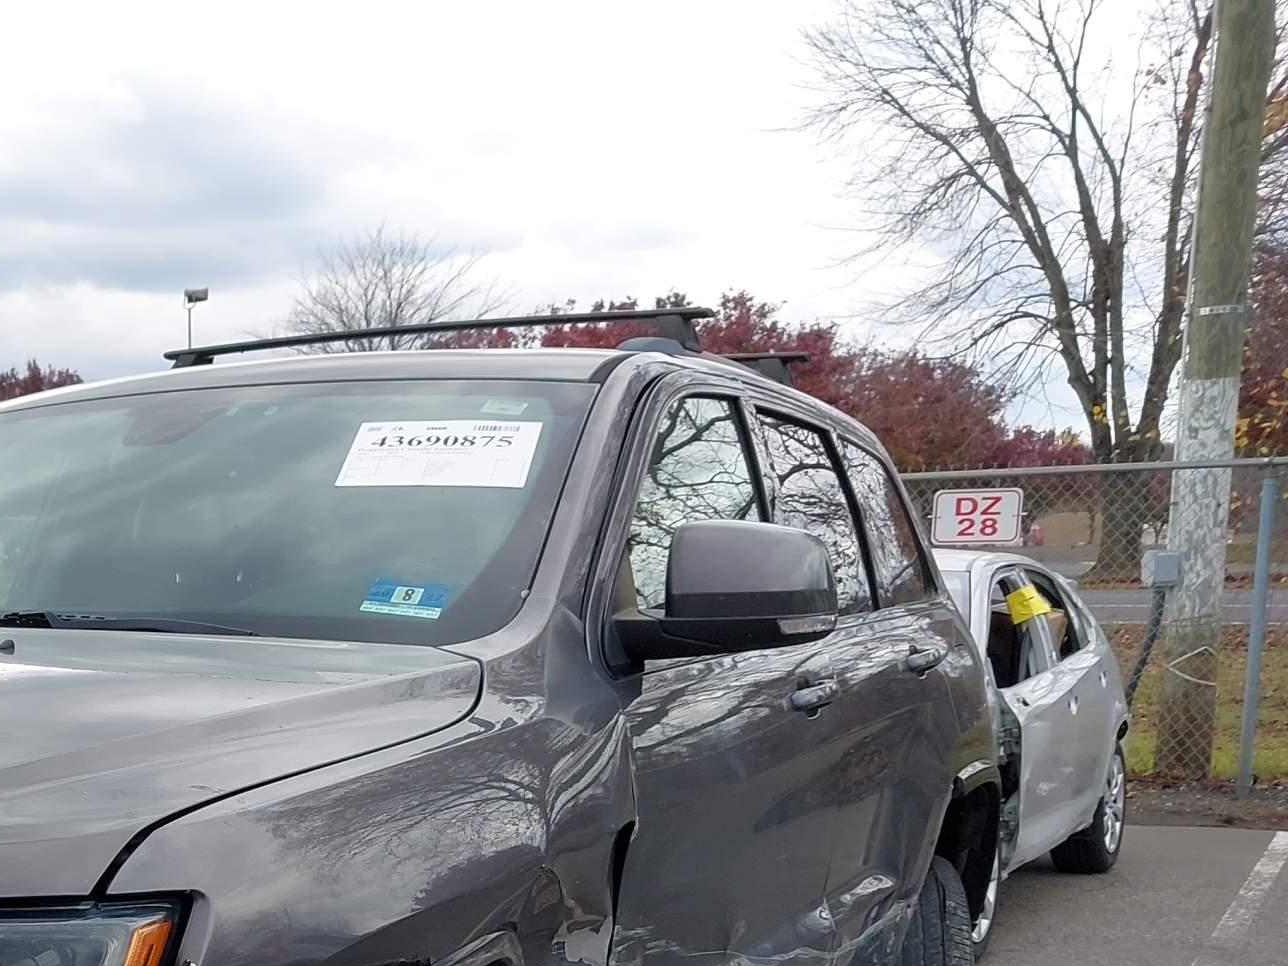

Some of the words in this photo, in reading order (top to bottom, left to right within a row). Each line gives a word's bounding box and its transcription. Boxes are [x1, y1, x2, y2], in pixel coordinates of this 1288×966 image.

[371, 435, 513, 448] 43690875
[955, 496, 1002, 516] DZ
[956, 518, 998, 537] 28
[402, 588, 416, 601] 8
